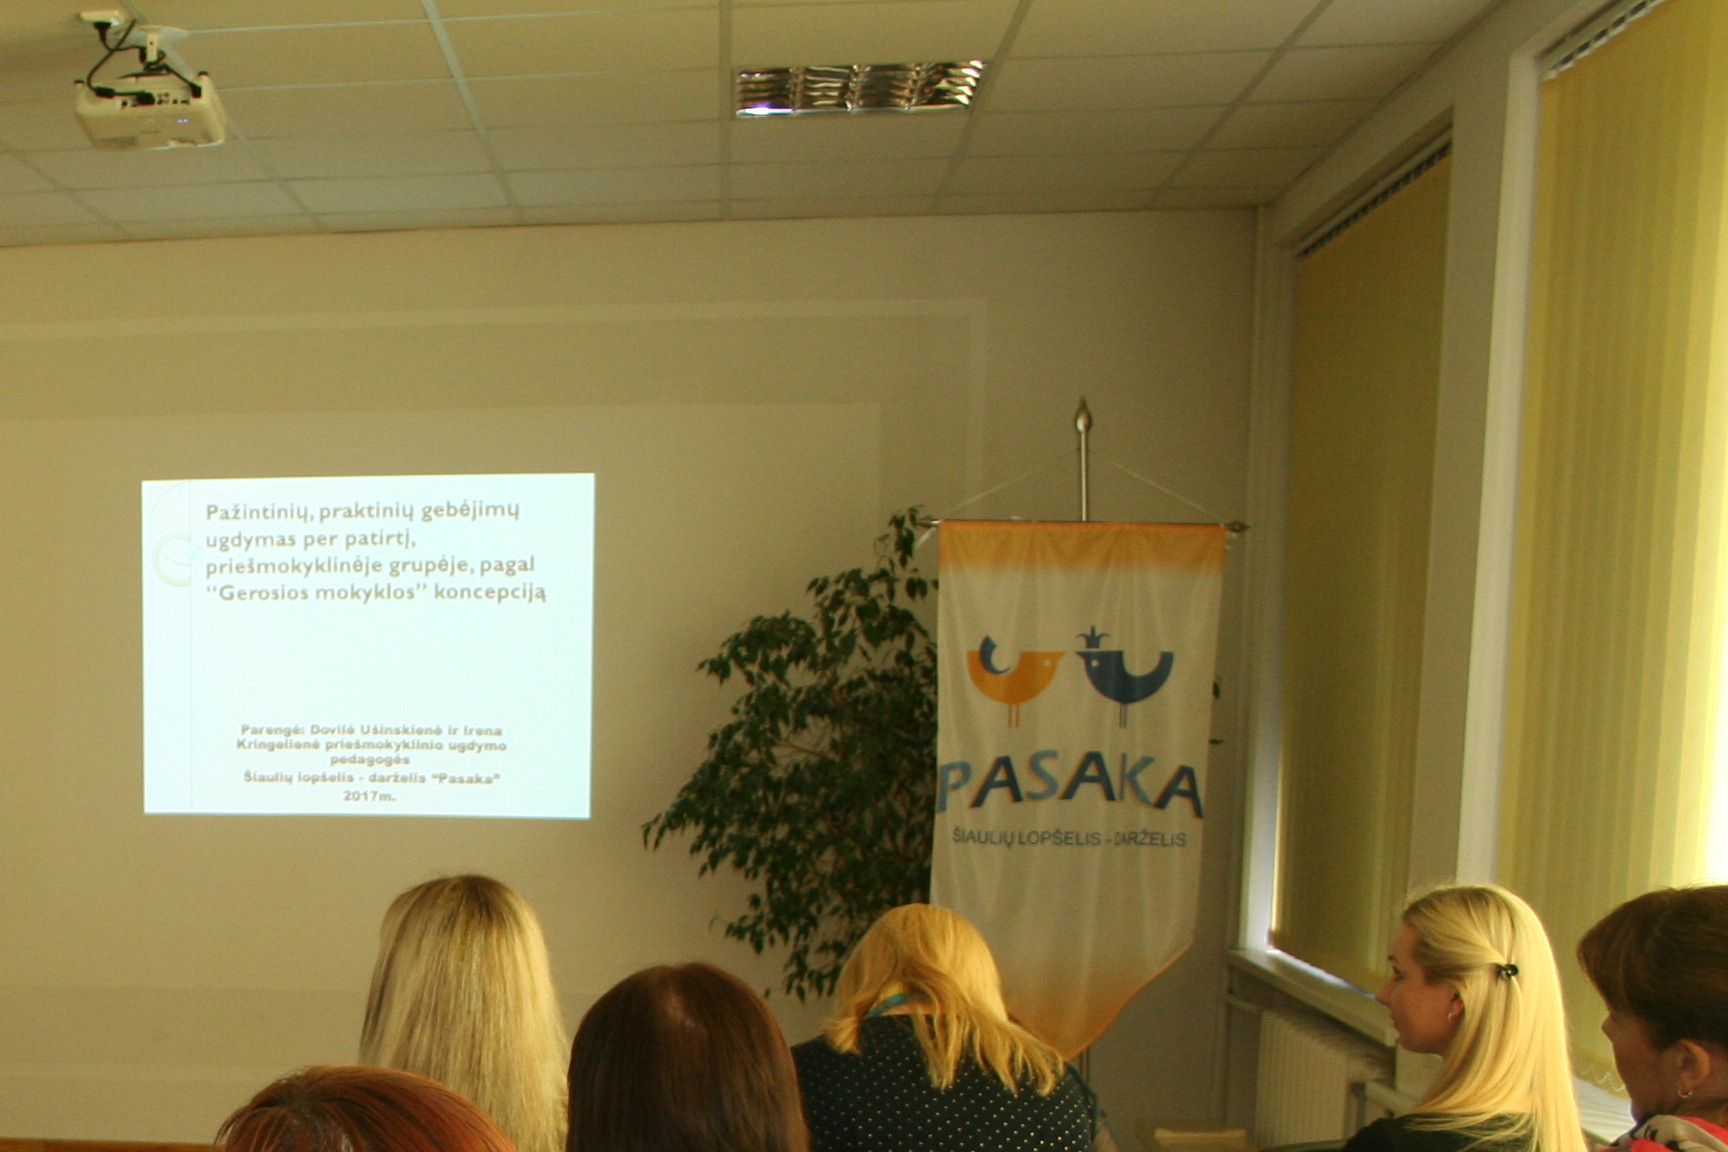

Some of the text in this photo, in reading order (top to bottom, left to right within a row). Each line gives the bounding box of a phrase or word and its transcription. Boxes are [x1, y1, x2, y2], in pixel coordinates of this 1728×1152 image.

[207, 499, 519, 523] Pažintinių, praktinių gebėjimų
[206, 528, 416, 552] ugdymas per patirtį,
[206, 555, 534, 579] priešmokyklinėje grupėje, pagal
[435, 582, 546, 604] koncepciją
[448, 725, 458, 735] ir
[449, 740, 507, 753] ugdymo
[936, 750, 1203, 818] PASAKA
[1019, 828, 1102, 846] LOPŠELIS
